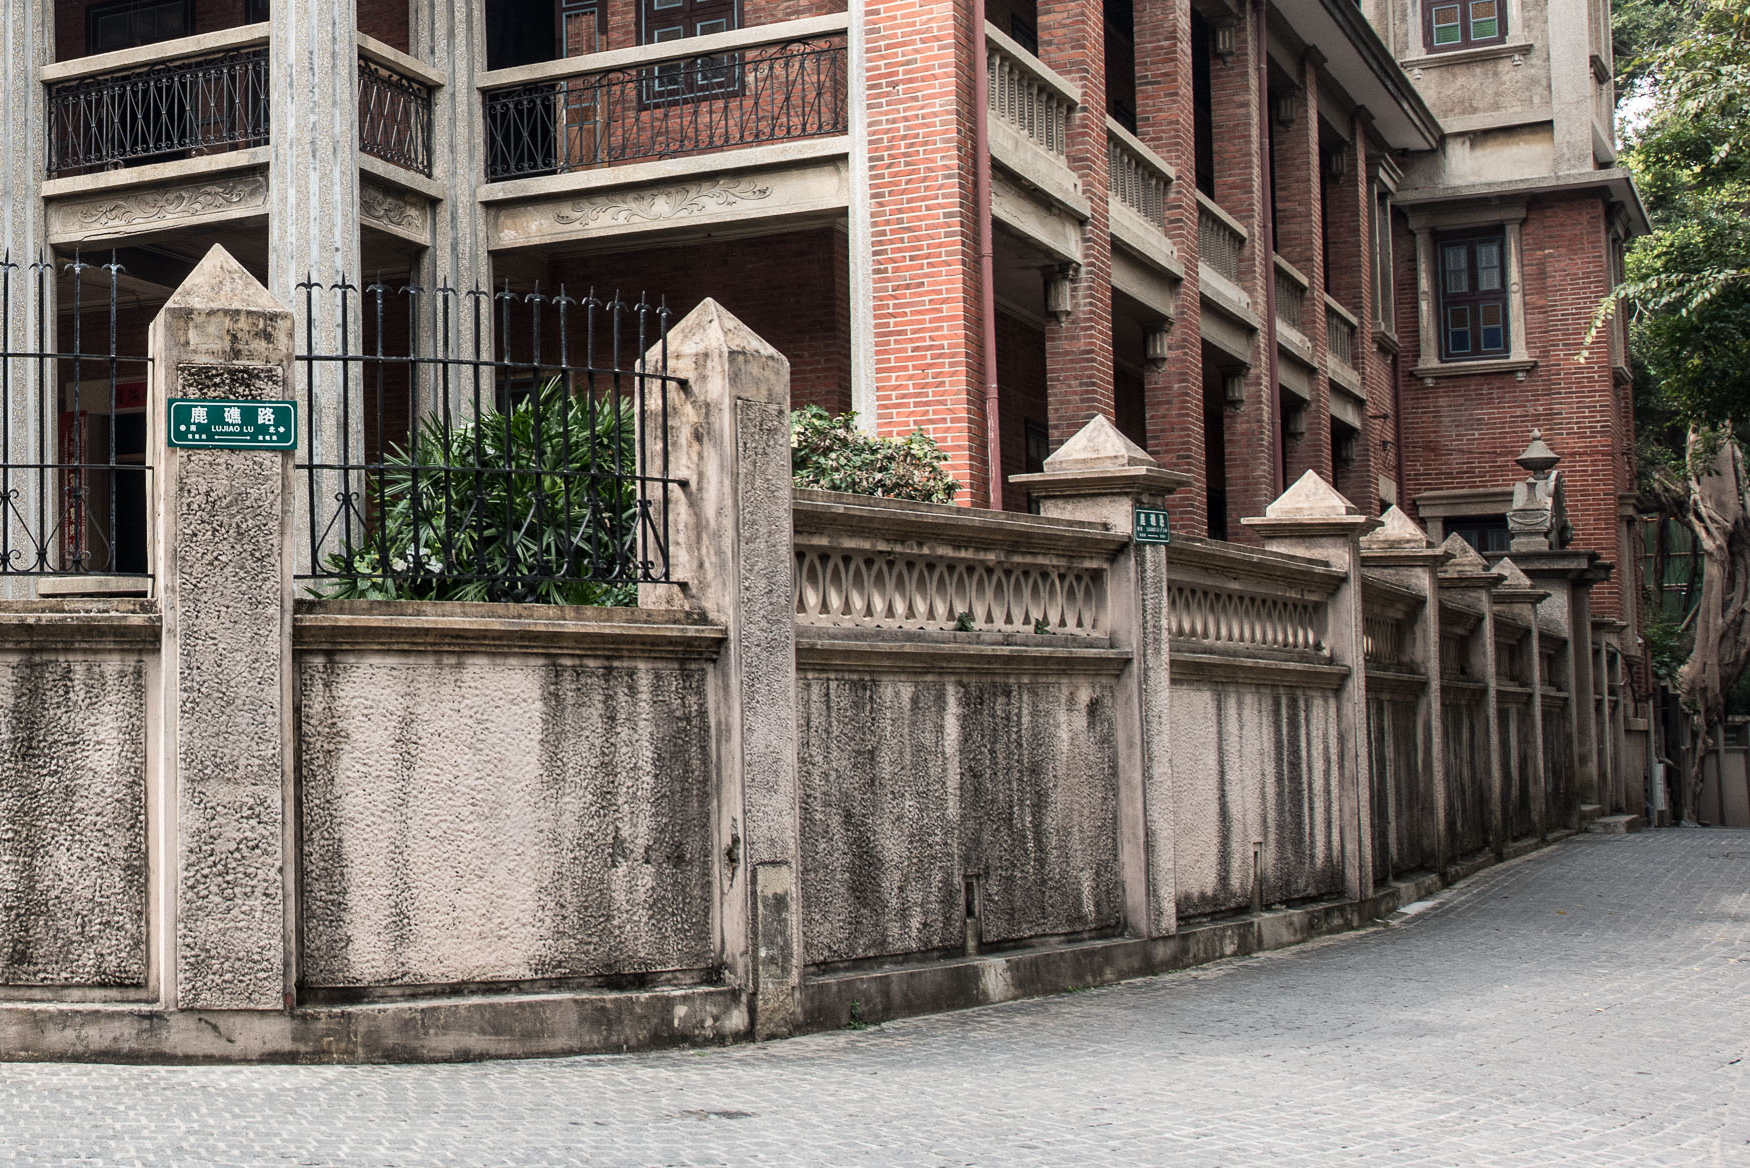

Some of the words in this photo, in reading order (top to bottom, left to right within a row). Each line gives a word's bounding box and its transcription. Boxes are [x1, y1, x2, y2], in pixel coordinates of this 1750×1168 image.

[190, 406, 275, 424] 鹿礁路
[211, 425, 240, 433] LUJIAO
